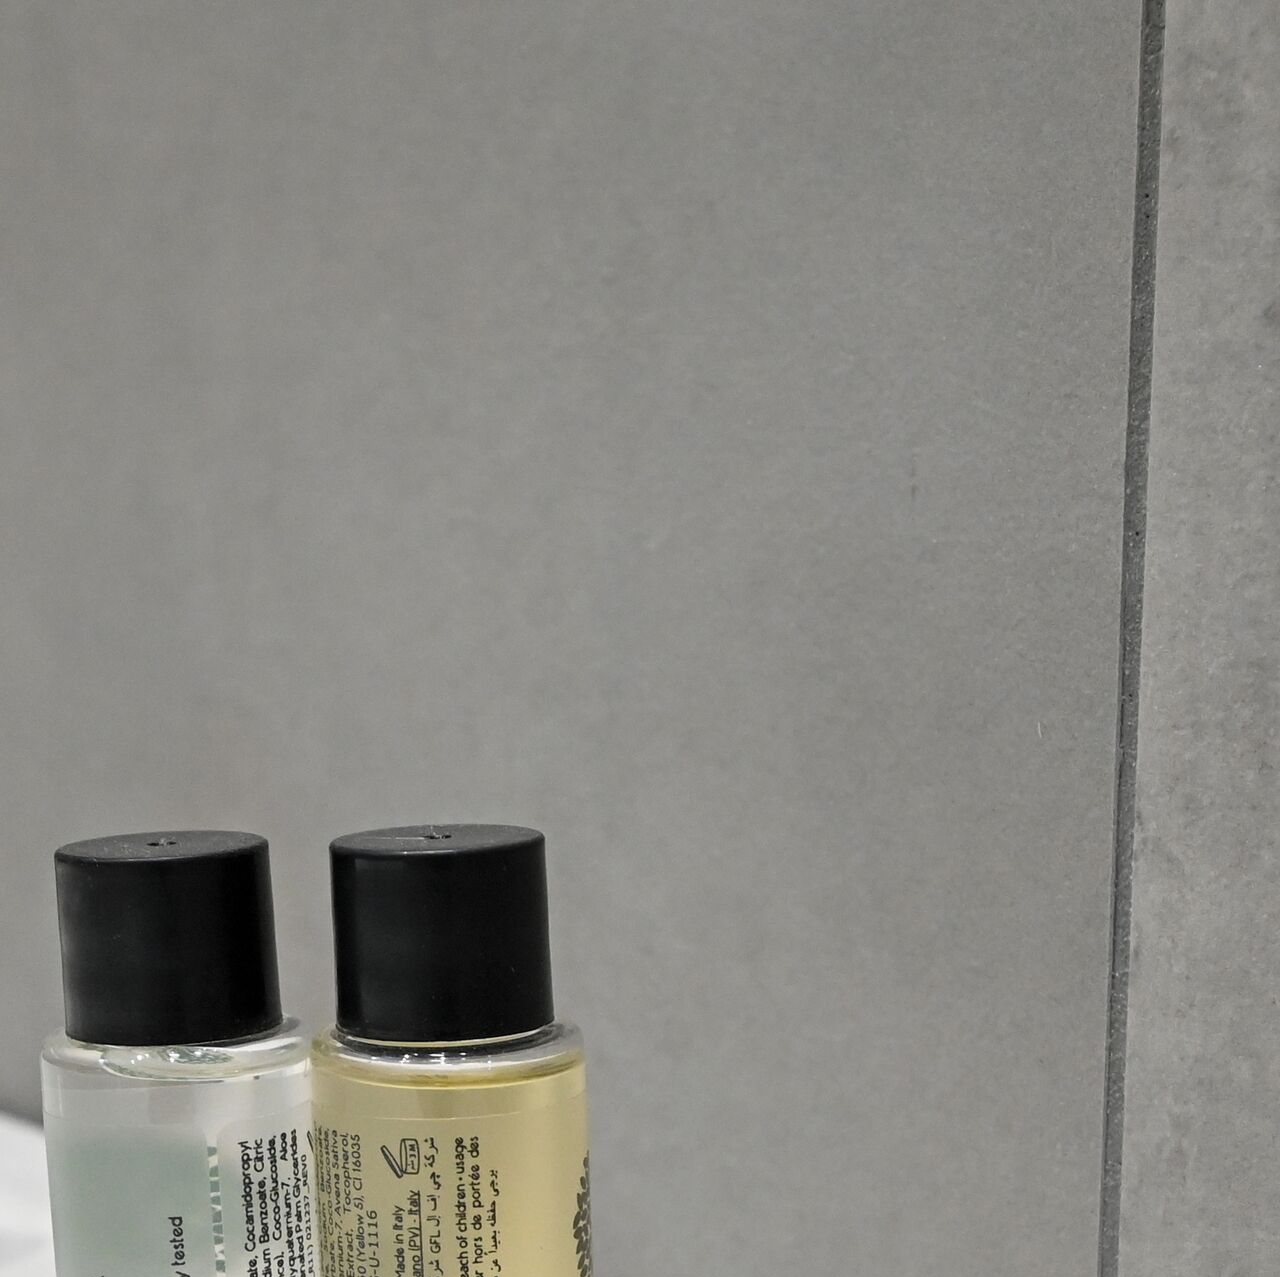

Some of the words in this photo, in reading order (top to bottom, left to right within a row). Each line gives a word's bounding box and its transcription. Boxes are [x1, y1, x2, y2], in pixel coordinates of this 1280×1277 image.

[252, 1138, 264, 1173] Citric
[350, 1134, 361, 1172] 16035
[454, 1136, 467, 1174] usage
[465, 1136, 480, 1158] des
[237, 1140, 256, 1252] Cocamidopropyl
[352, 1177, 363, 1191] CI
[467, 1164, 483, 1208] portée
[256, 1176, 270, 1244] Benzoate,
[353, 1195, 364, 1210] 5),
[392, 1205, 405, 1231] Italy
[454, 1183, 468, 1233] children
[355, 1213, 367, 1262] (Yellow
[470, 1214, 482, 1230] de
[167, 1216, 186, 1266] tested
[393, 1233, 404, 1244] in
[429, 1229, 441, 1254] GFL
[455, 1235, 468, 1249] of
[472, 1236, 483, 1264] hors
